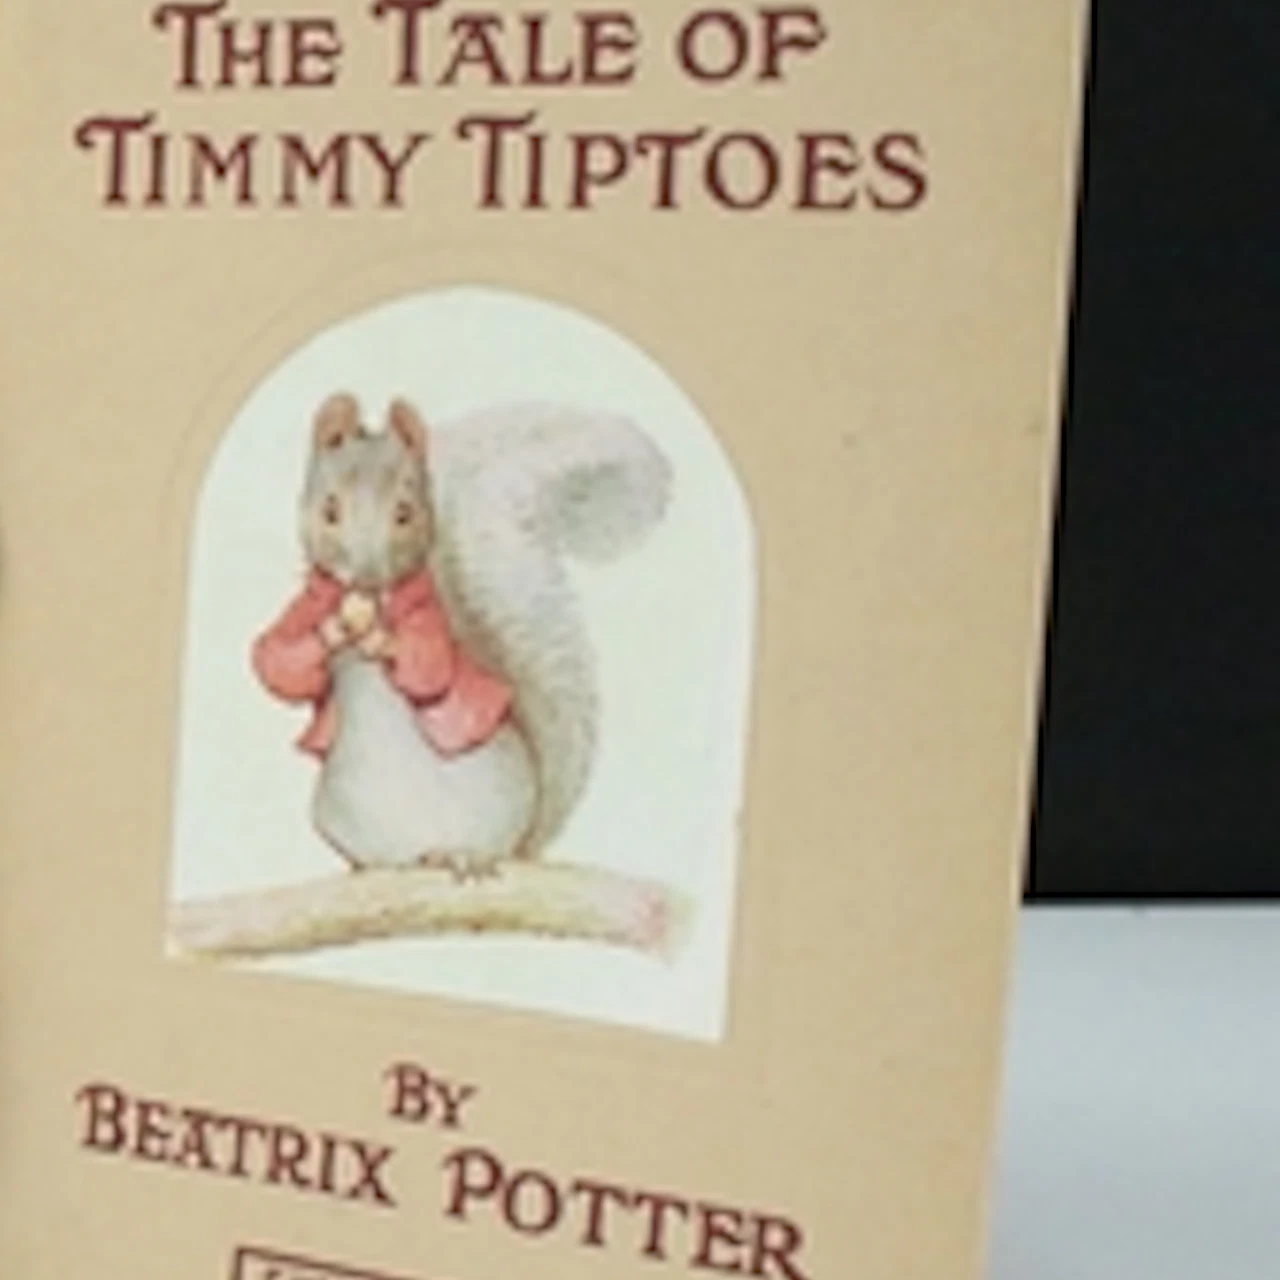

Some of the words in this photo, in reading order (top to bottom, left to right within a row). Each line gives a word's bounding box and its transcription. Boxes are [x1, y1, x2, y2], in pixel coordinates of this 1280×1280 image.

[674, 4, 828, 84] OF
[74, 112, 433, 208] TIMMY
[455, 110, 930, 214] TIPTOES
[382, 1062, 477, 1129] BY
[75, 1083, 398, 1209] BEATRIX
